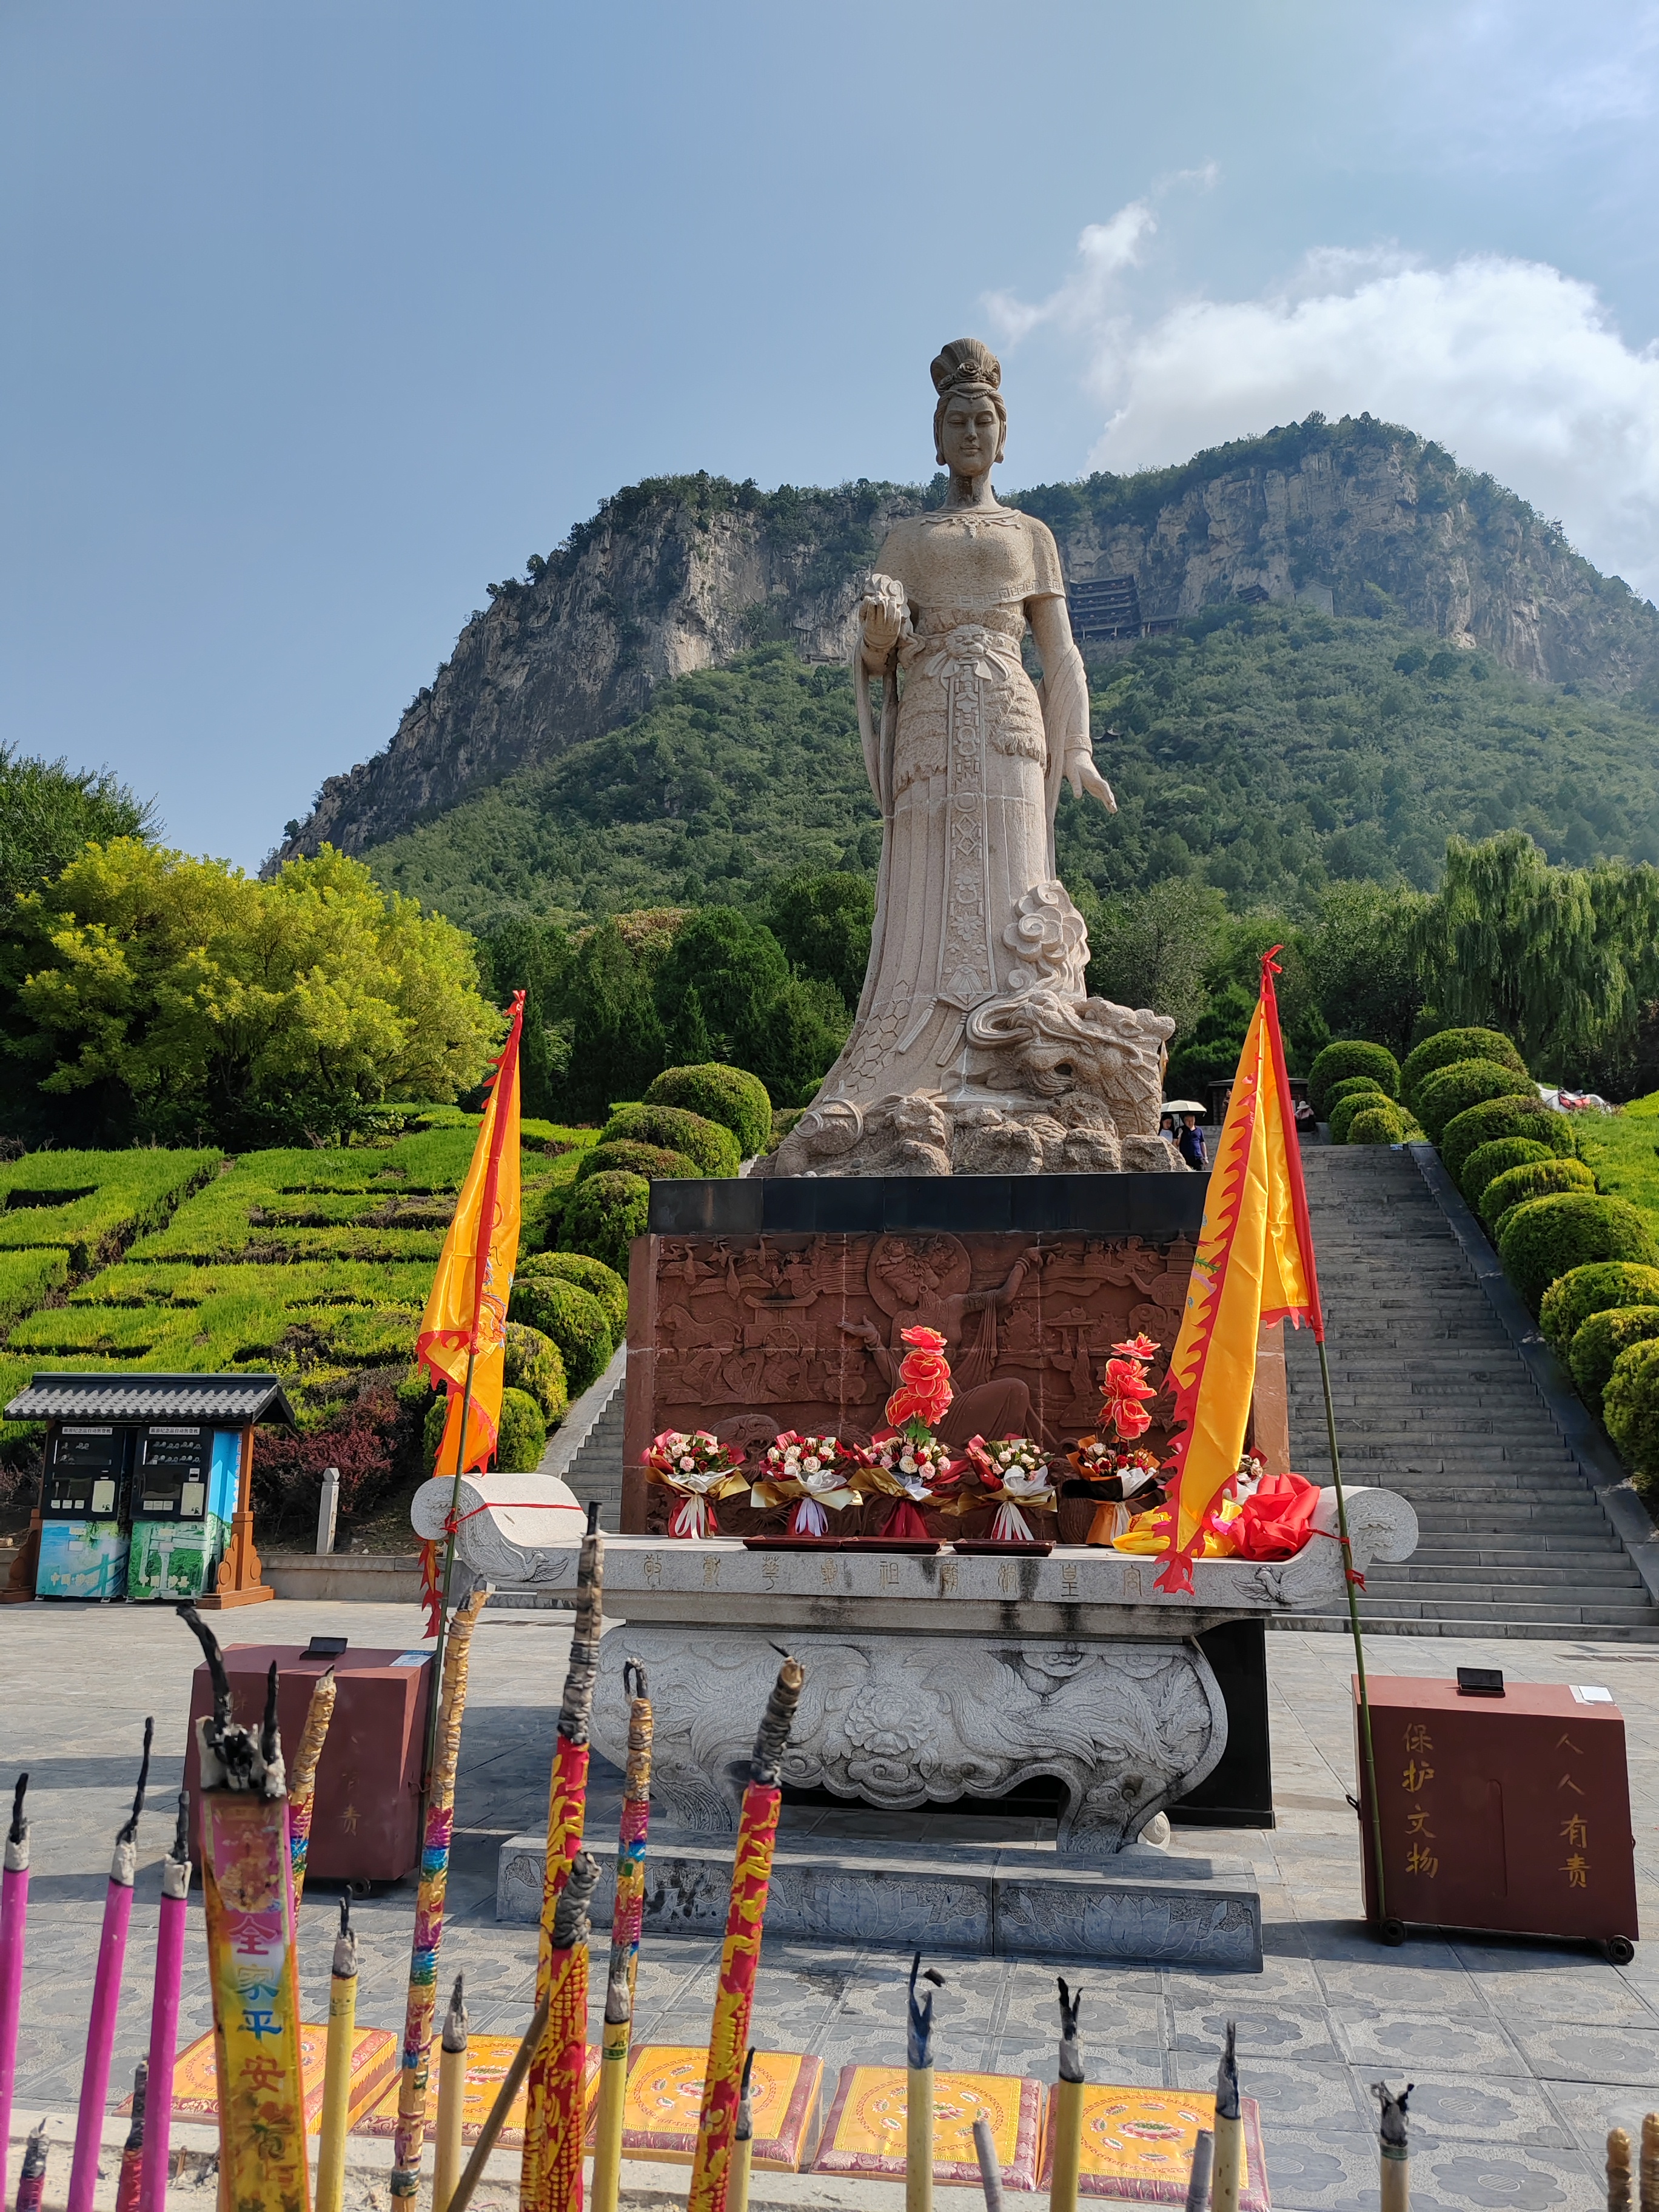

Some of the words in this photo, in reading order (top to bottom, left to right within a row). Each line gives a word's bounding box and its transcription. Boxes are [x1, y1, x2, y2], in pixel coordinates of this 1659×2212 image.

[1401, 1723, 1439, 1879] 保护文物
[1555, 1733, 1592, 1888] 人人有责
[228, 1915, 286, 2093] 全家平安
